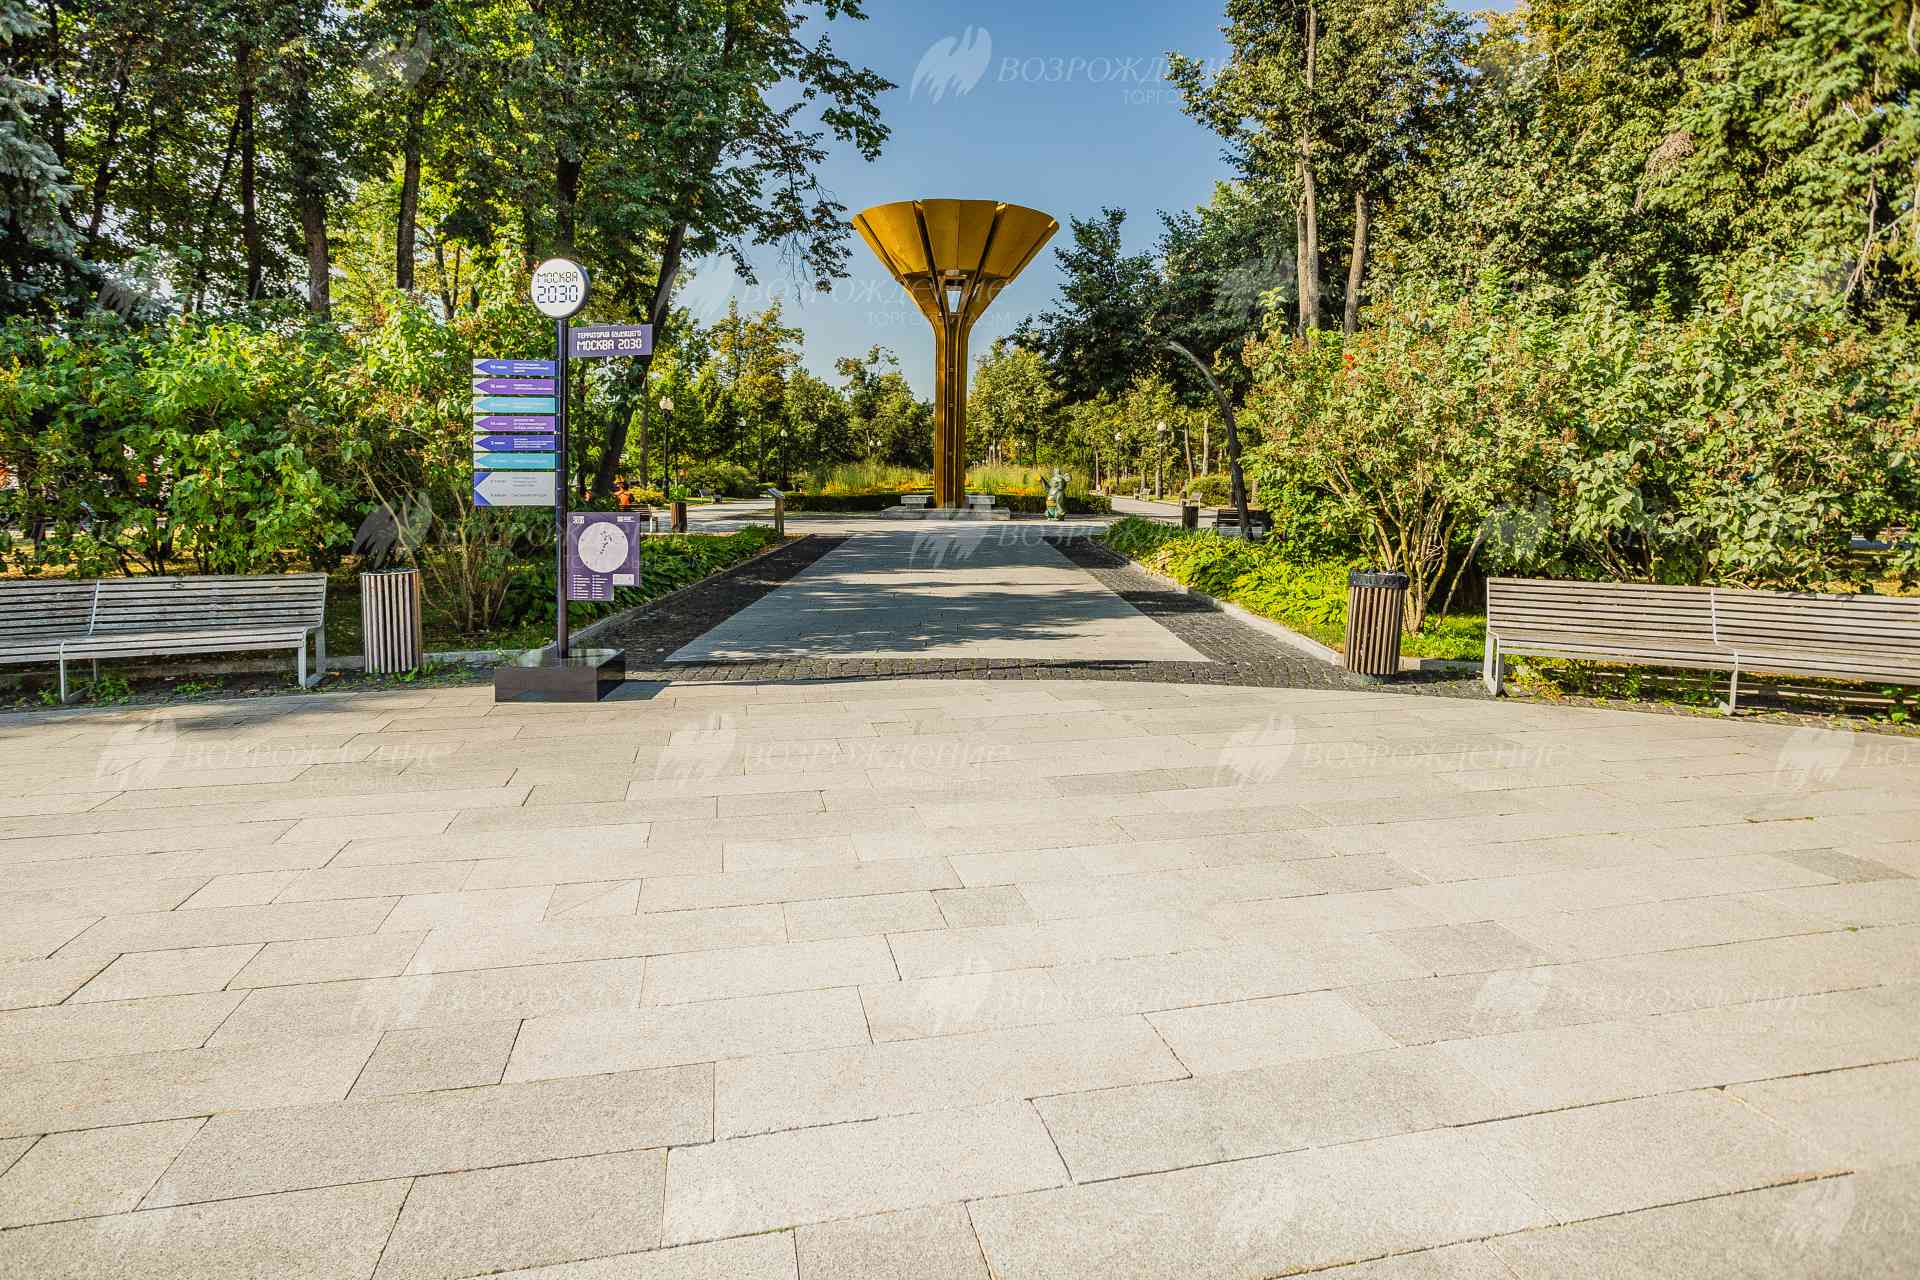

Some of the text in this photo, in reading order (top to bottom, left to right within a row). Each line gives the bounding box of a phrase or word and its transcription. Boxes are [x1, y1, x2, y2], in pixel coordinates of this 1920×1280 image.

[536, 271, 578, 284] МОСКВА
[536, 285, 578, 304] 2030
[576, 338, 642, 352] МОСКВА 2030
